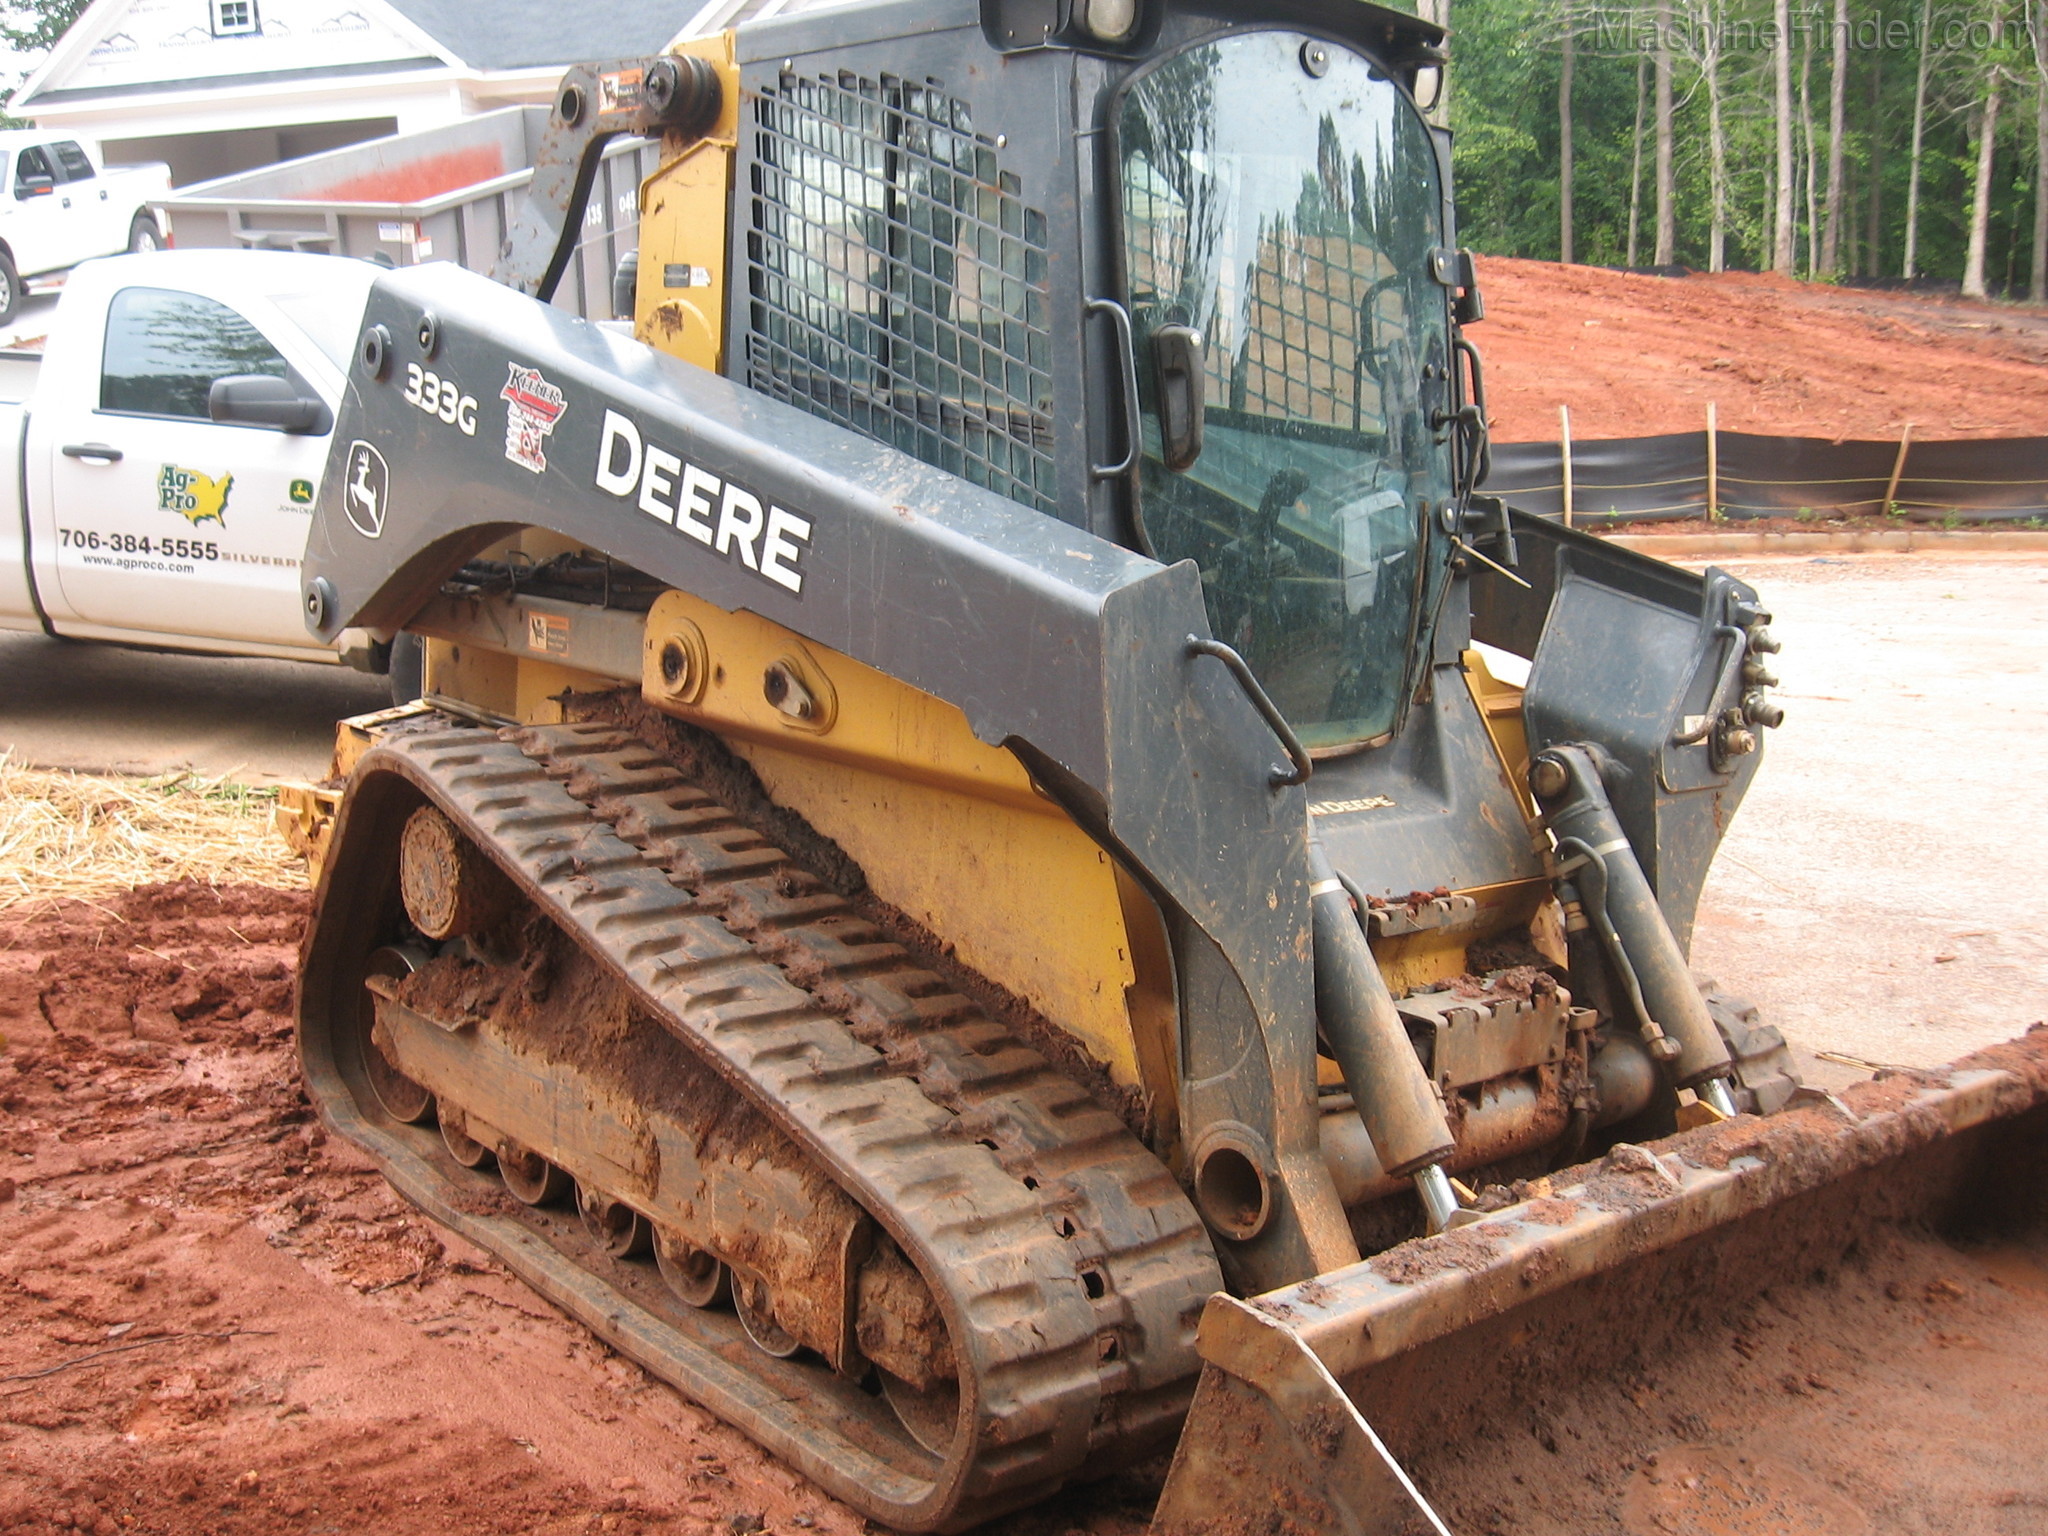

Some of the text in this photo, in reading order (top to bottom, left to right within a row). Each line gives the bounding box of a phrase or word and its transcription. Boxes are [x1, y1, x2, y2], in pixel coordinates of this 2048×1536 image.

[404, 362, 478, 436] 333G
[160, 463, 197, 492] Ag-
[159, 487, 198, 512] Pro
[277, 504, 299, 514] JOHN
[595, 408, 812, 594] DEERE
[59, 528, 219, 562] 706-384-5555
[82, 553, 196, 574] www.agproco.com
